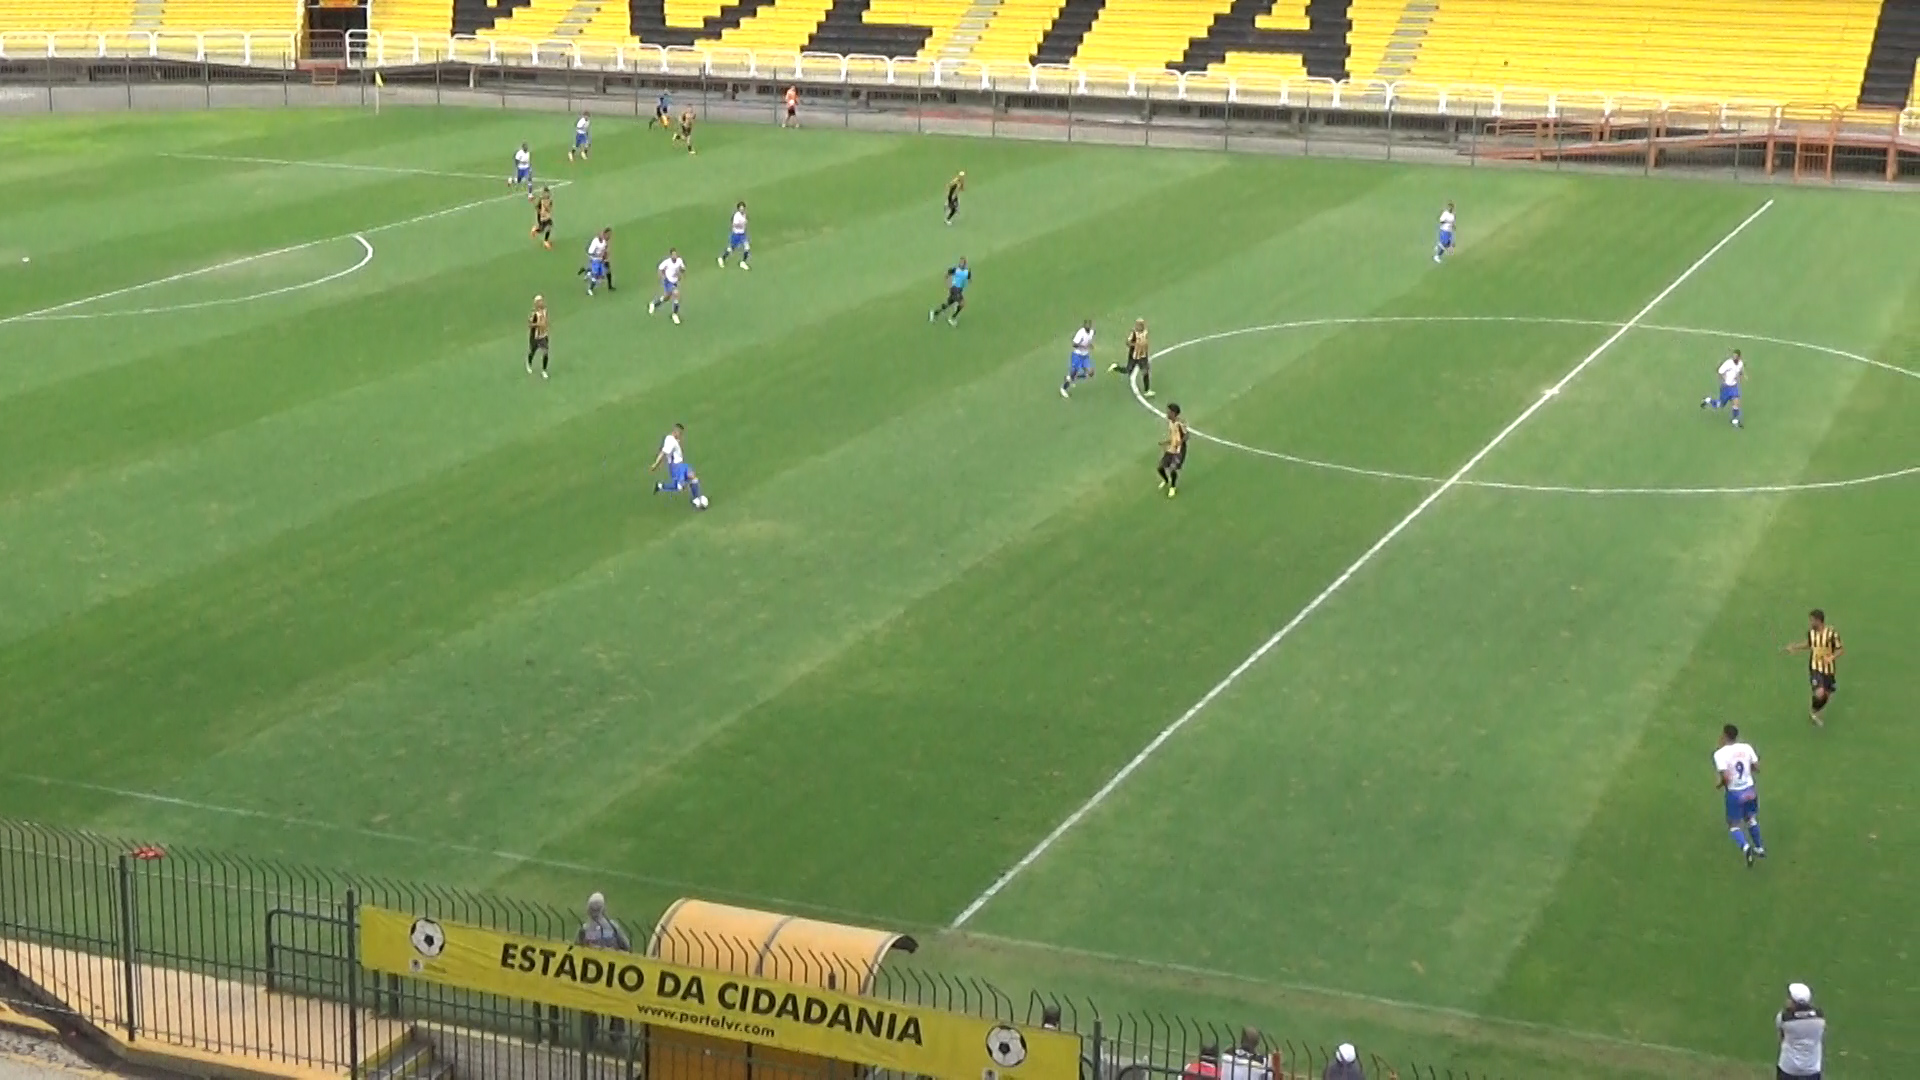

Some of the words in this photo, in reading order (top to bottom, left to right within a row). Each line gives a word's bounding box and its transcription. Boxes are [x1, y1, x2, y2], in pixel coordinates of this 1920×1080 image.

[1735, 761, 1744, 780] 9
[501, 943, 644, 992] ESTÁDIO
[657, 970, 705, 1005] DA
[717, 981, 924, 1047] CIDADANIA
[637, 1004, 775, 1038] www.portalvr.com
